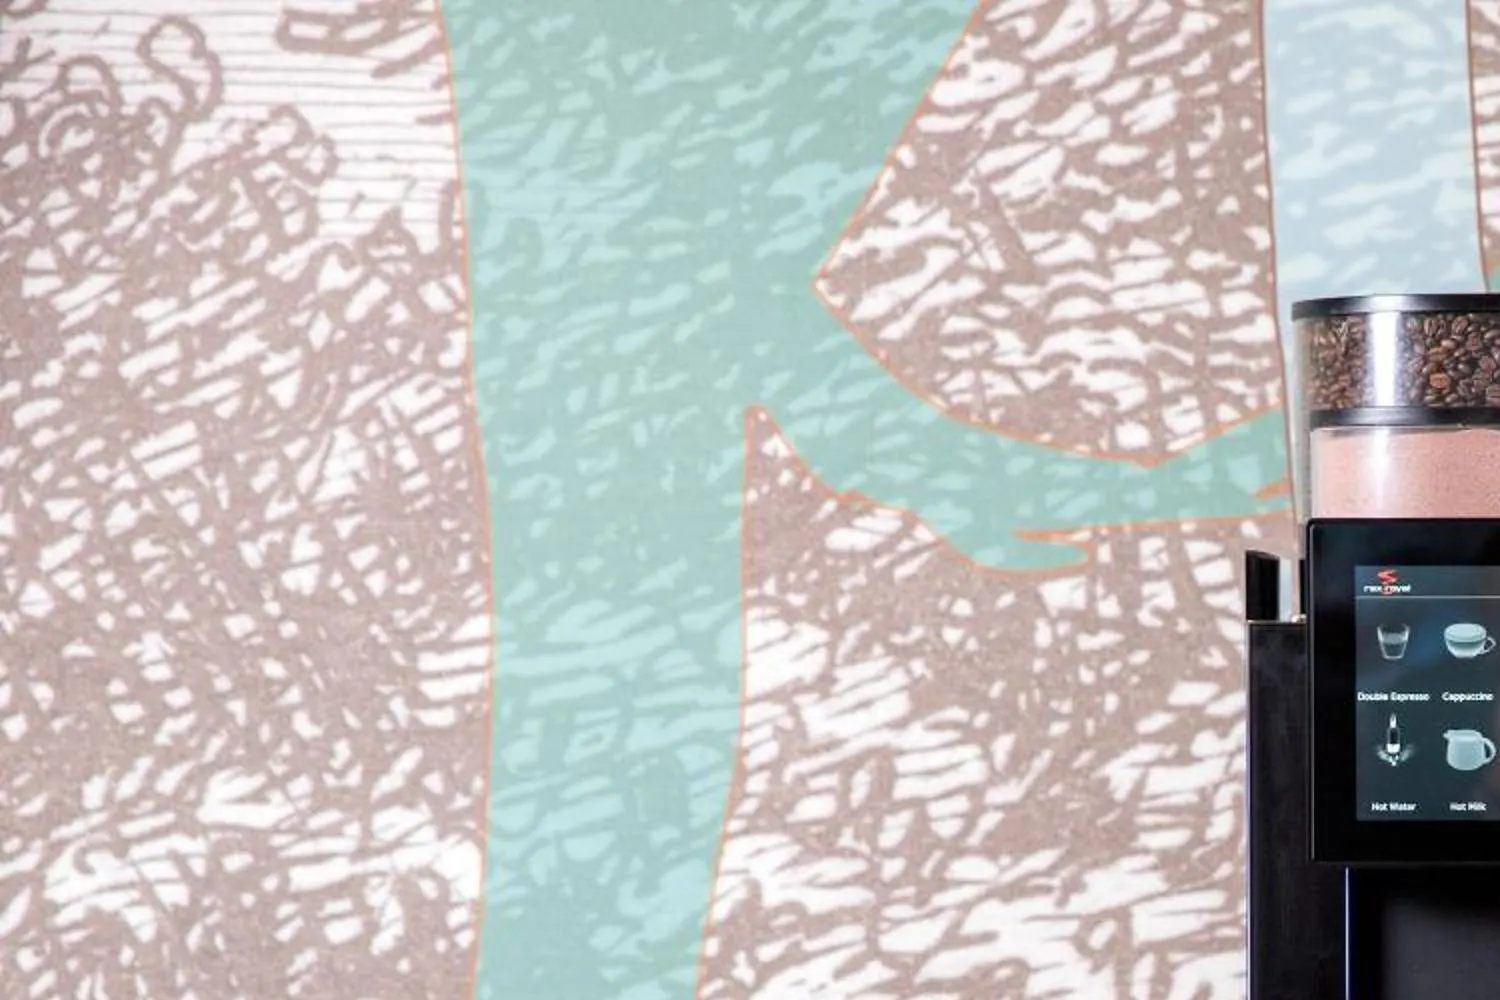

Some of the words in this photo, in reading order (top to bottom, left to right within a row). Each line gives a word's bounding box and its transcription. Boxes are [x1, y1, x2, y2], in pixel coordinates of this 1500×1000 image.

[1357, 691, 1389, 702] Double
[1390, 691, 1431, 704] Espresso
[1441, 691, 1494, 703] Cappuccino
[1371, 802, 1388, 812] Hot
[1389, 802, 1417, 812] Water
[1450, 802, 1466, 812] Hot
[1468, 801, 1487, 812] Milk
